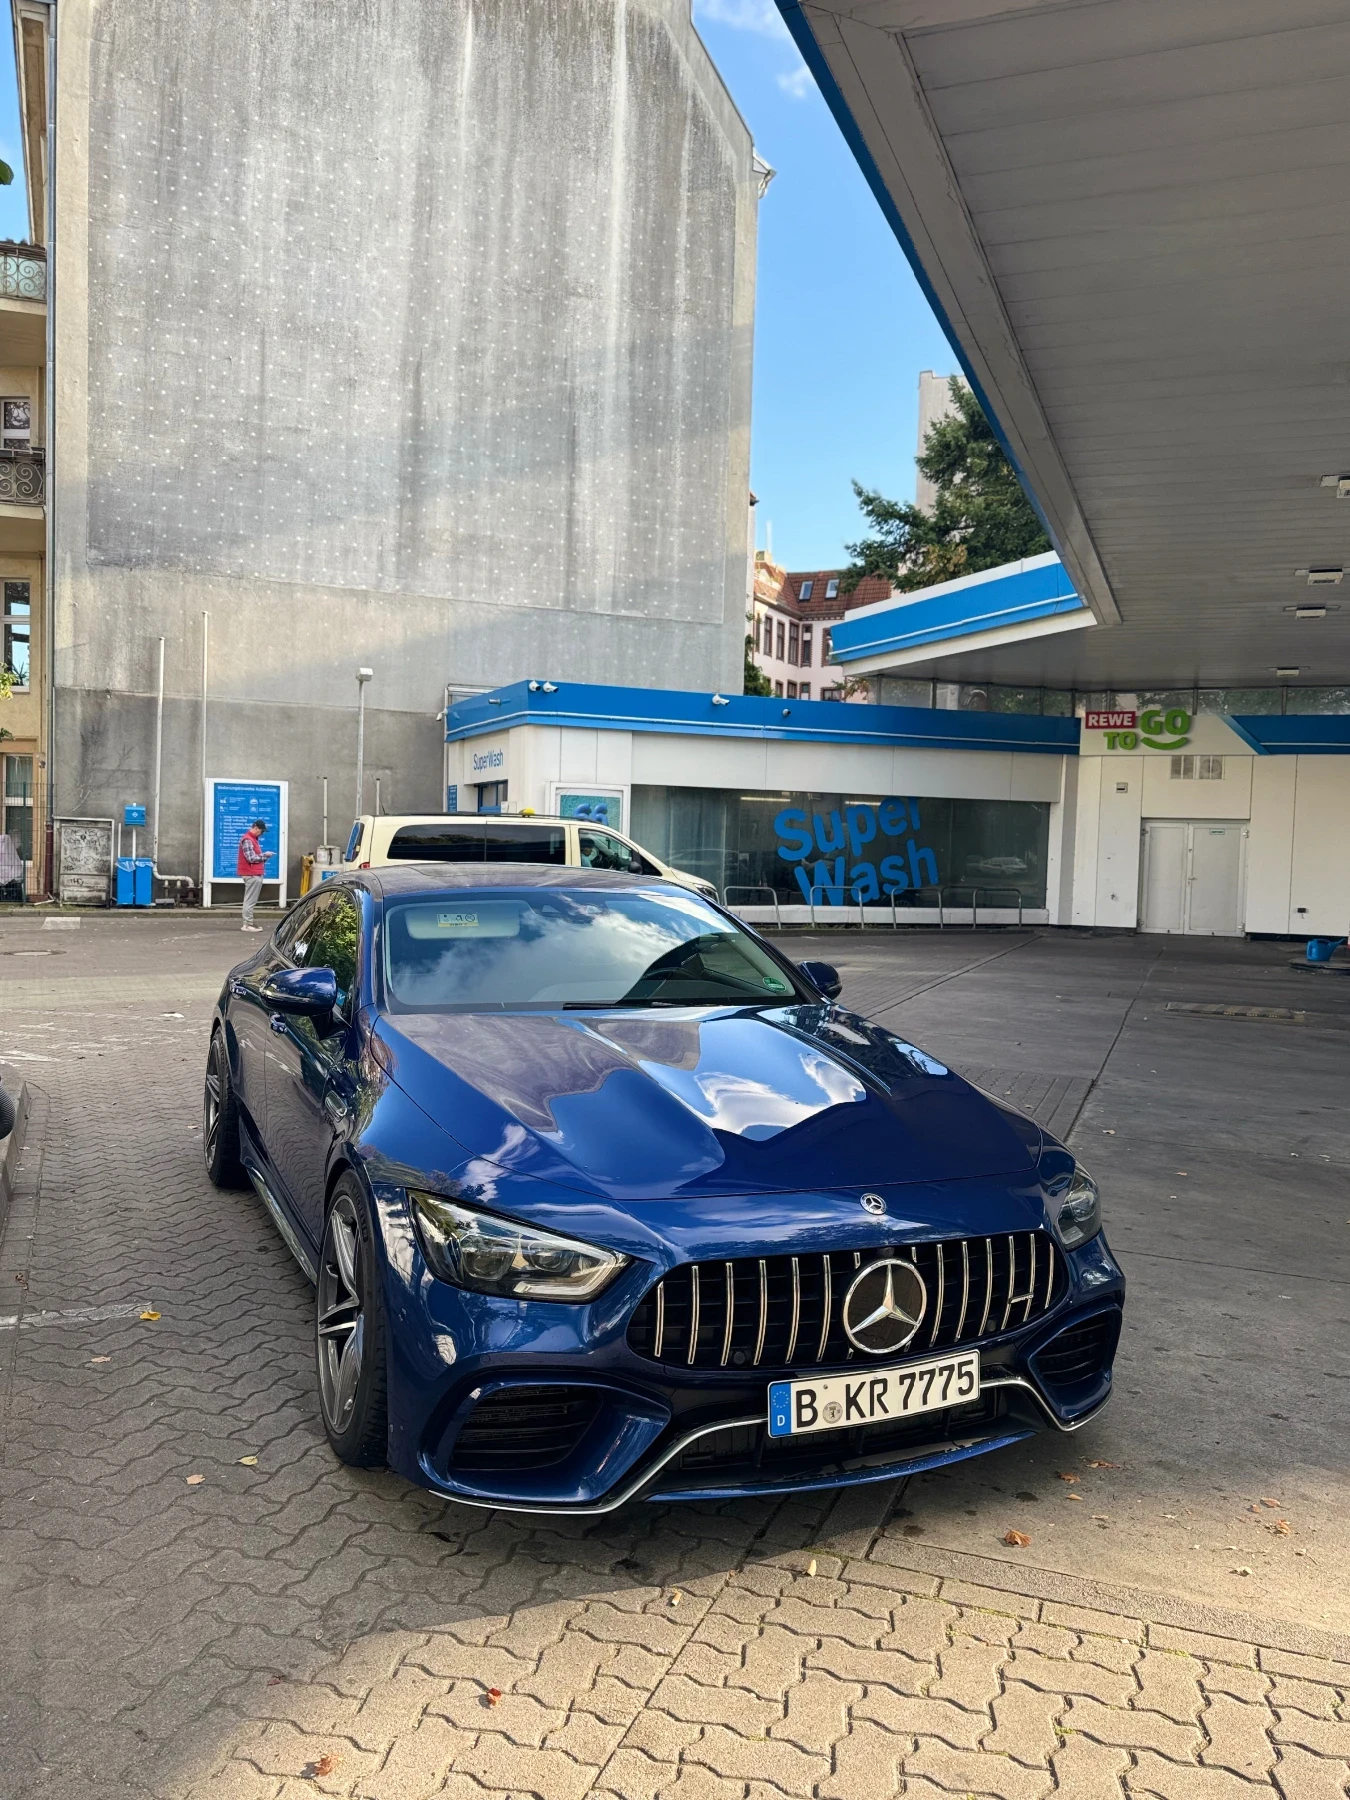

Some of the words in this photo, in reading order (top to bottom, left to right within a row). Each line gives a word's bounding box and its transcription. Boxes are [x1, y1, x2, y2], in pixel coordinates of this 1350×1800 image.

[1088, 713, 1133, 727] REWE
[1103, 731, 1137, 750] TO
[1140, 709, 1190, 735] GO
[473, 748, 504, 773] SuperWash
[793, 838, 939, 906] Wash
[777, 1414, 786, 1427] D
[796, 1388, 818, 1429] B
[845, 1377, 890, 1421] KR
[899, 1359, 975, 1411] 7775
